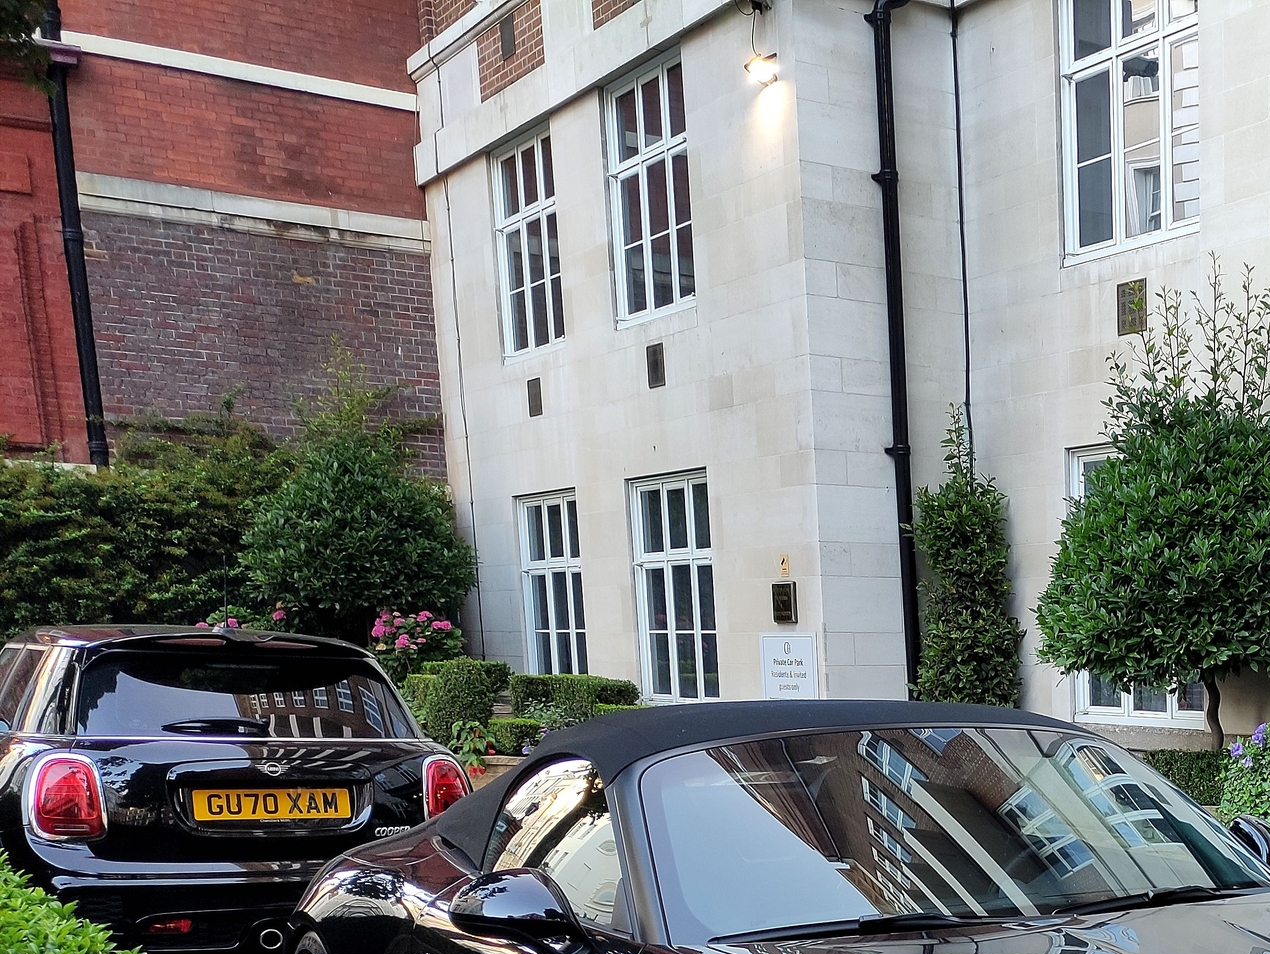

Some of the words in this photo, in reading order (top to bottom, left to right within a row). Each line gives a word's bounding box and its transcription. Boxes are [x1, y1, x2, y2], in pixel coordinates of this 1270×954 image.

[773, 658, 787, 666] Private
[794, 658, 804, 667] Park
[206, 793, 279, 815] GU70
[287, 792, 339, 814] XAM
